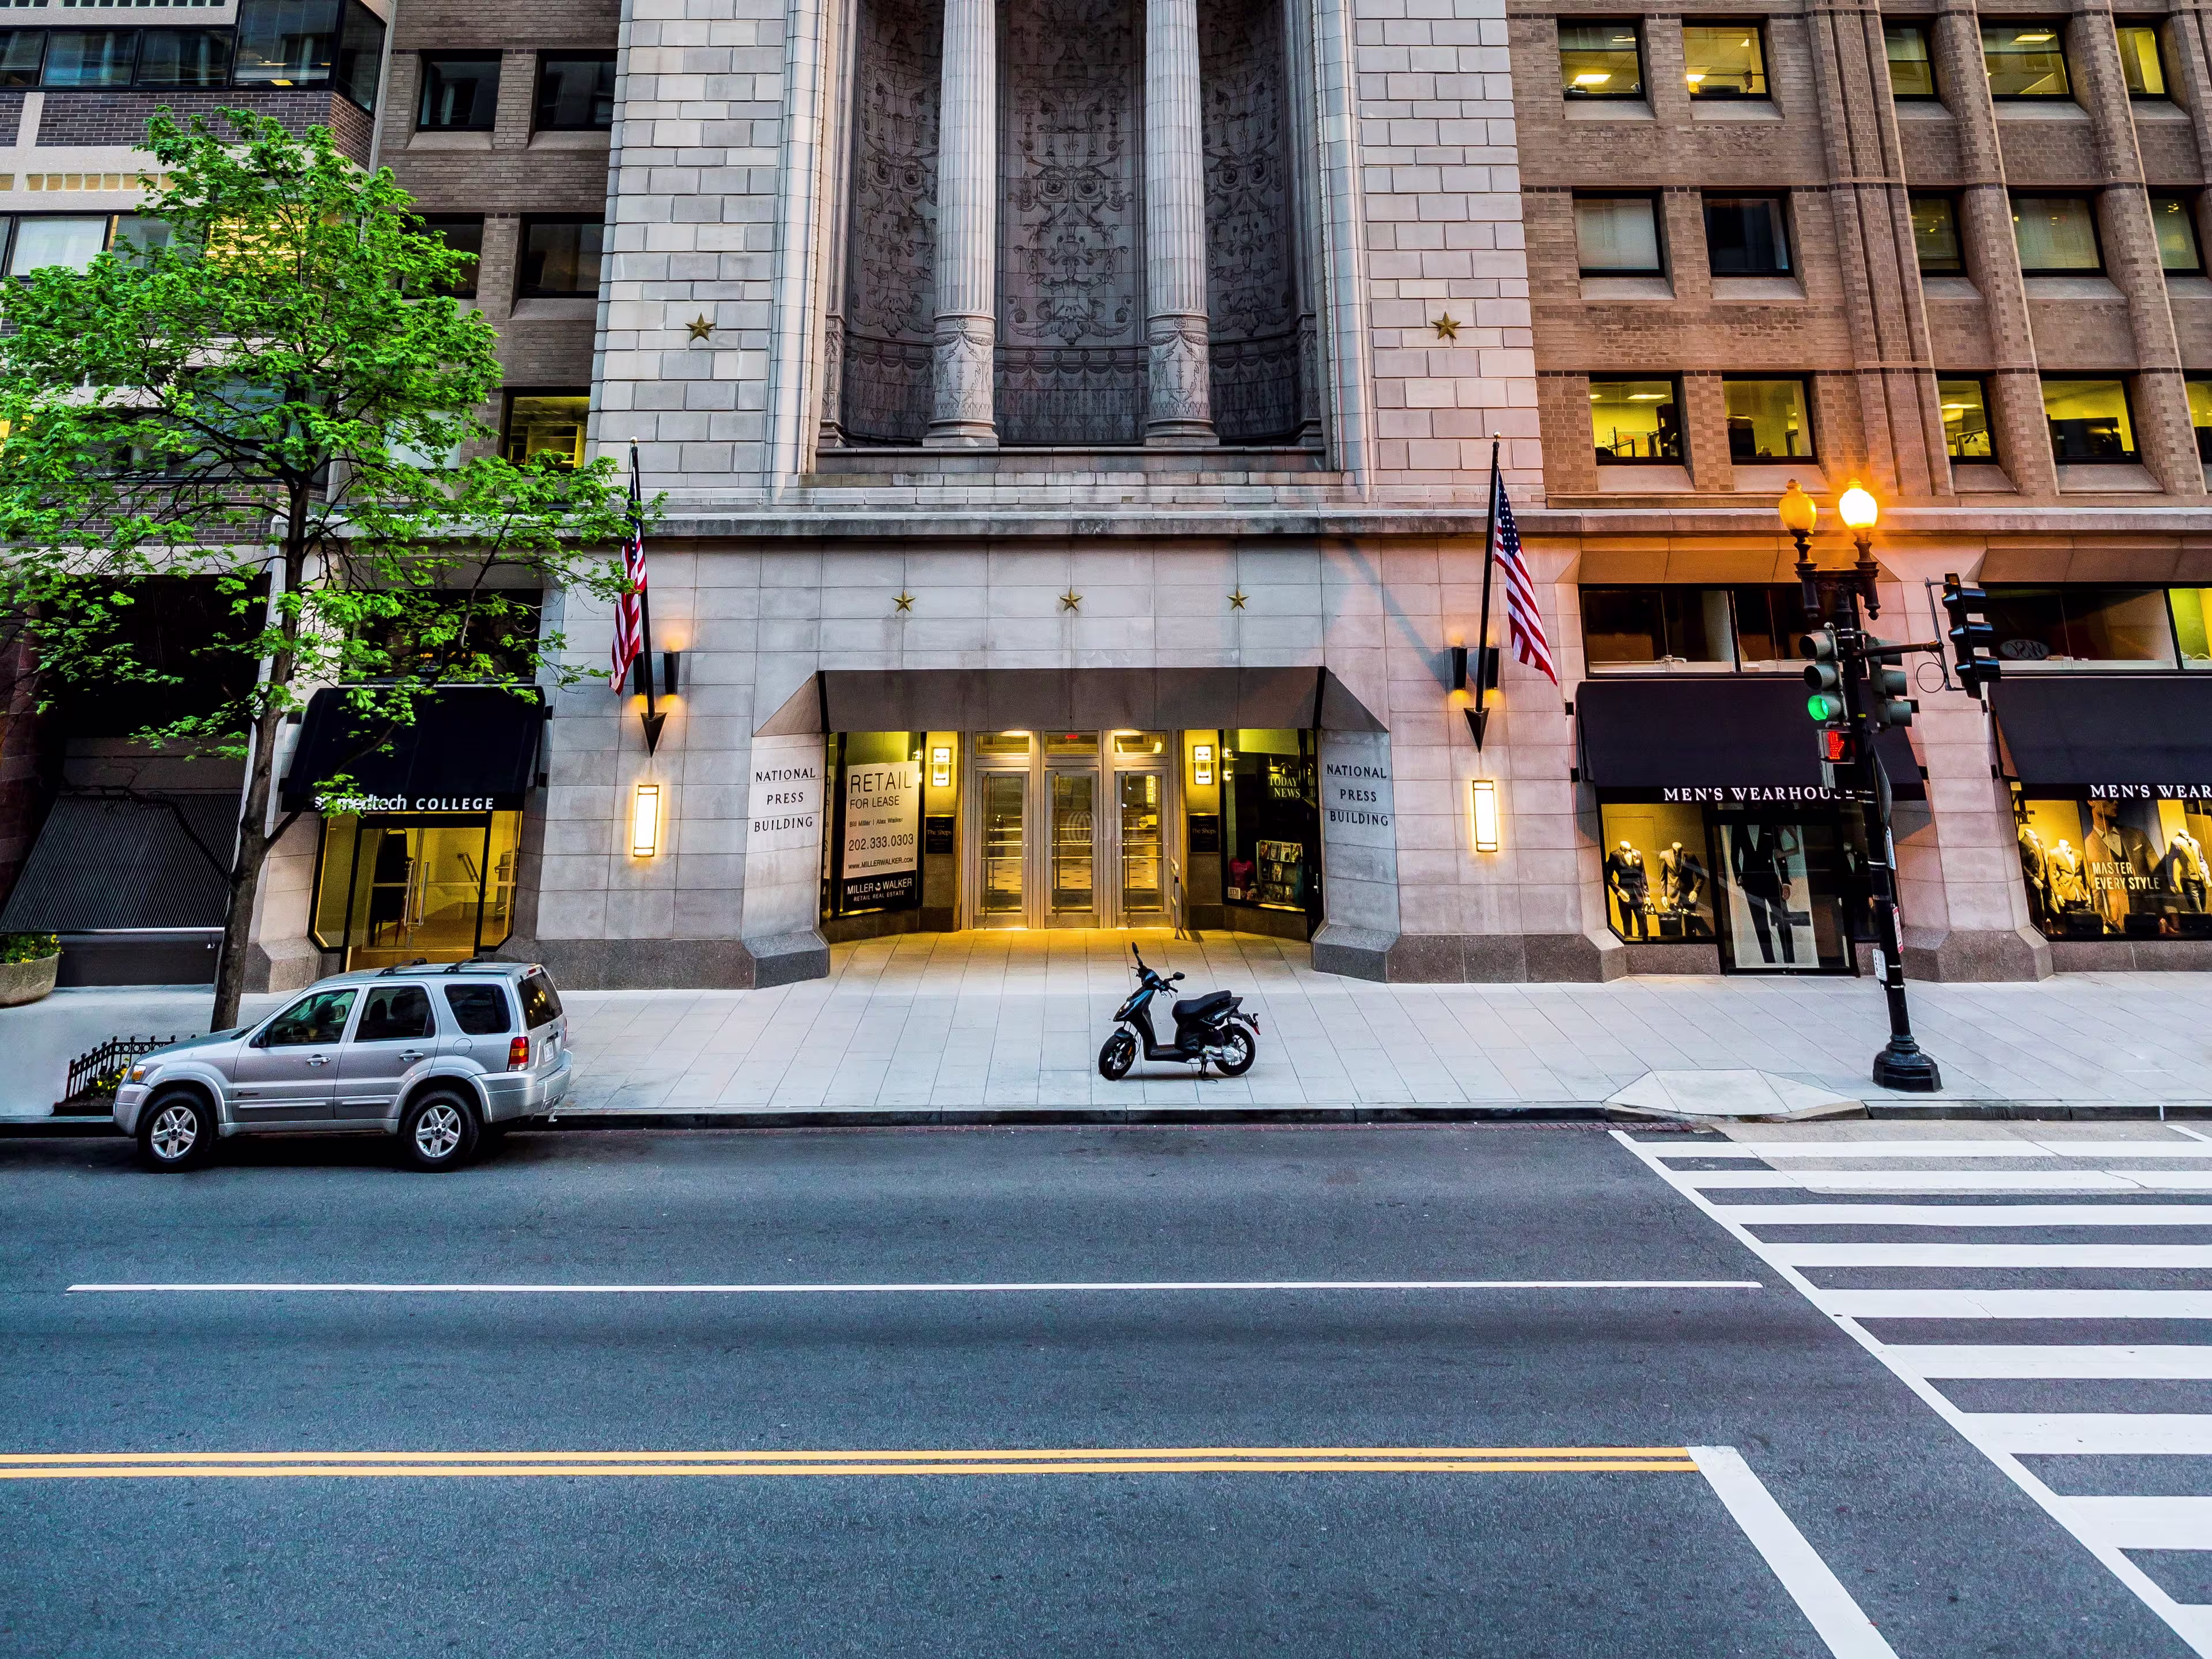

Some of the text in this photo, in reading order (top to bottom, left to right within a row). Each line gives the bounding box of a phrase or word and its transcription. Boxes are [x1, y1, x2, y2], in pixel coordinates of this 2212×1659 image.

[756, 768, 816, 782] NATIONAL
[1327, 764, 1387, 779] NATIONAL
[850, 771, 912, 794] RETAIL
[767, 792, 804, 805] PRESS
[1274, 787, 1300, 798] NEWS
[1340, 788, 1377, 802] PRESS
[1664, 787, 1723, 801] MEN'S
[2090, 785, 2212, 798] MEN'S WEAR
[336, 794, 494, 810] medtech COLLEGE
[850, 796, 900, 809] FOR LEASE
[755, 817, 813, 832] BUILDING
[1330, 811, 1388, 827] BUILDING
[849, 834, 914, 851] 202.333.0303
[2092, 862, 2133, 874] MASTER
[847, 878, 912, 895] MILLER WALKER
[2094, 876, 2160, 890] EVERY STYLE
